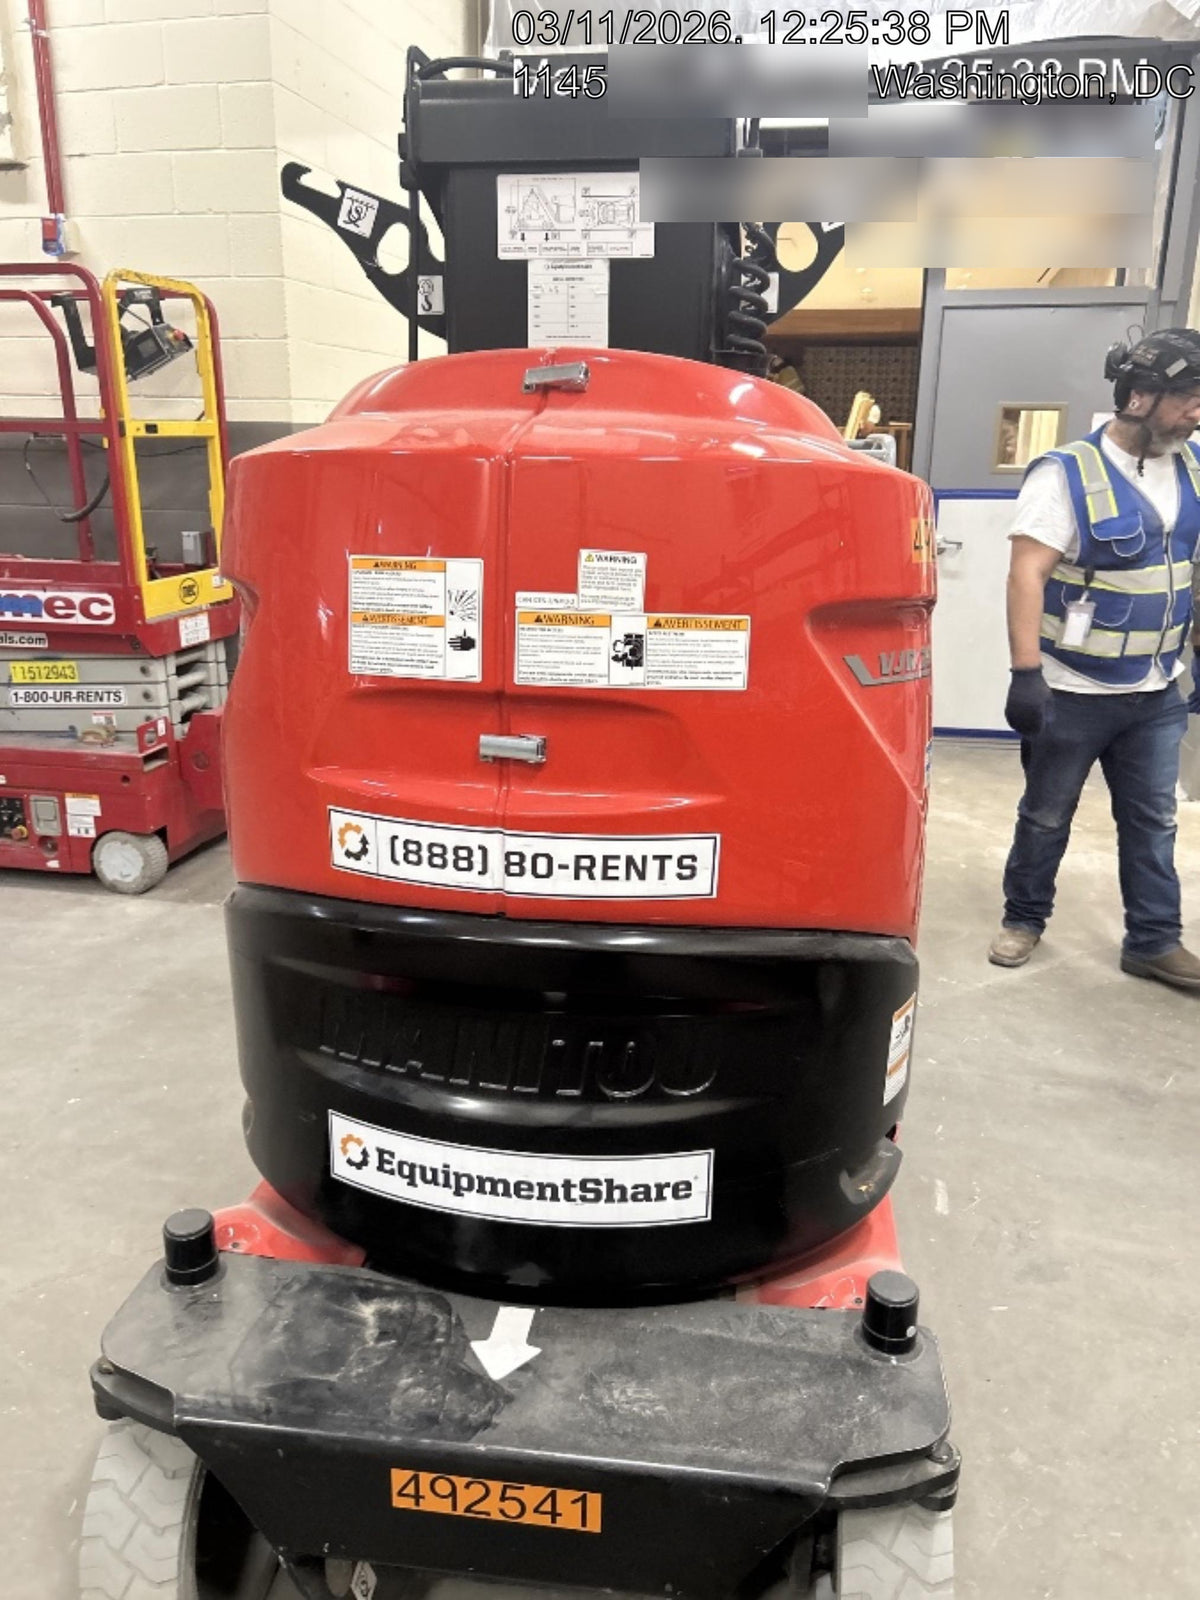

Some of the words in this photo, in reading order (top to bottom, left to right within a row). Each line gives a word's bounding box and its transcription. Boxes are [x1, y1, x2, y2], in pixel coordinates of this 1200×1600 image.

[543, 614, 595, 625] WARNING
[13, 690, 122, 703] 1-800-UR-RENTS
[389, 834, 488, 876] (888)
[504, 850, 698, 882] 80-RENTS
[375, 1146, 693, 1204] EquipmentShare
[396, 1472, 588, 1529] 492541
